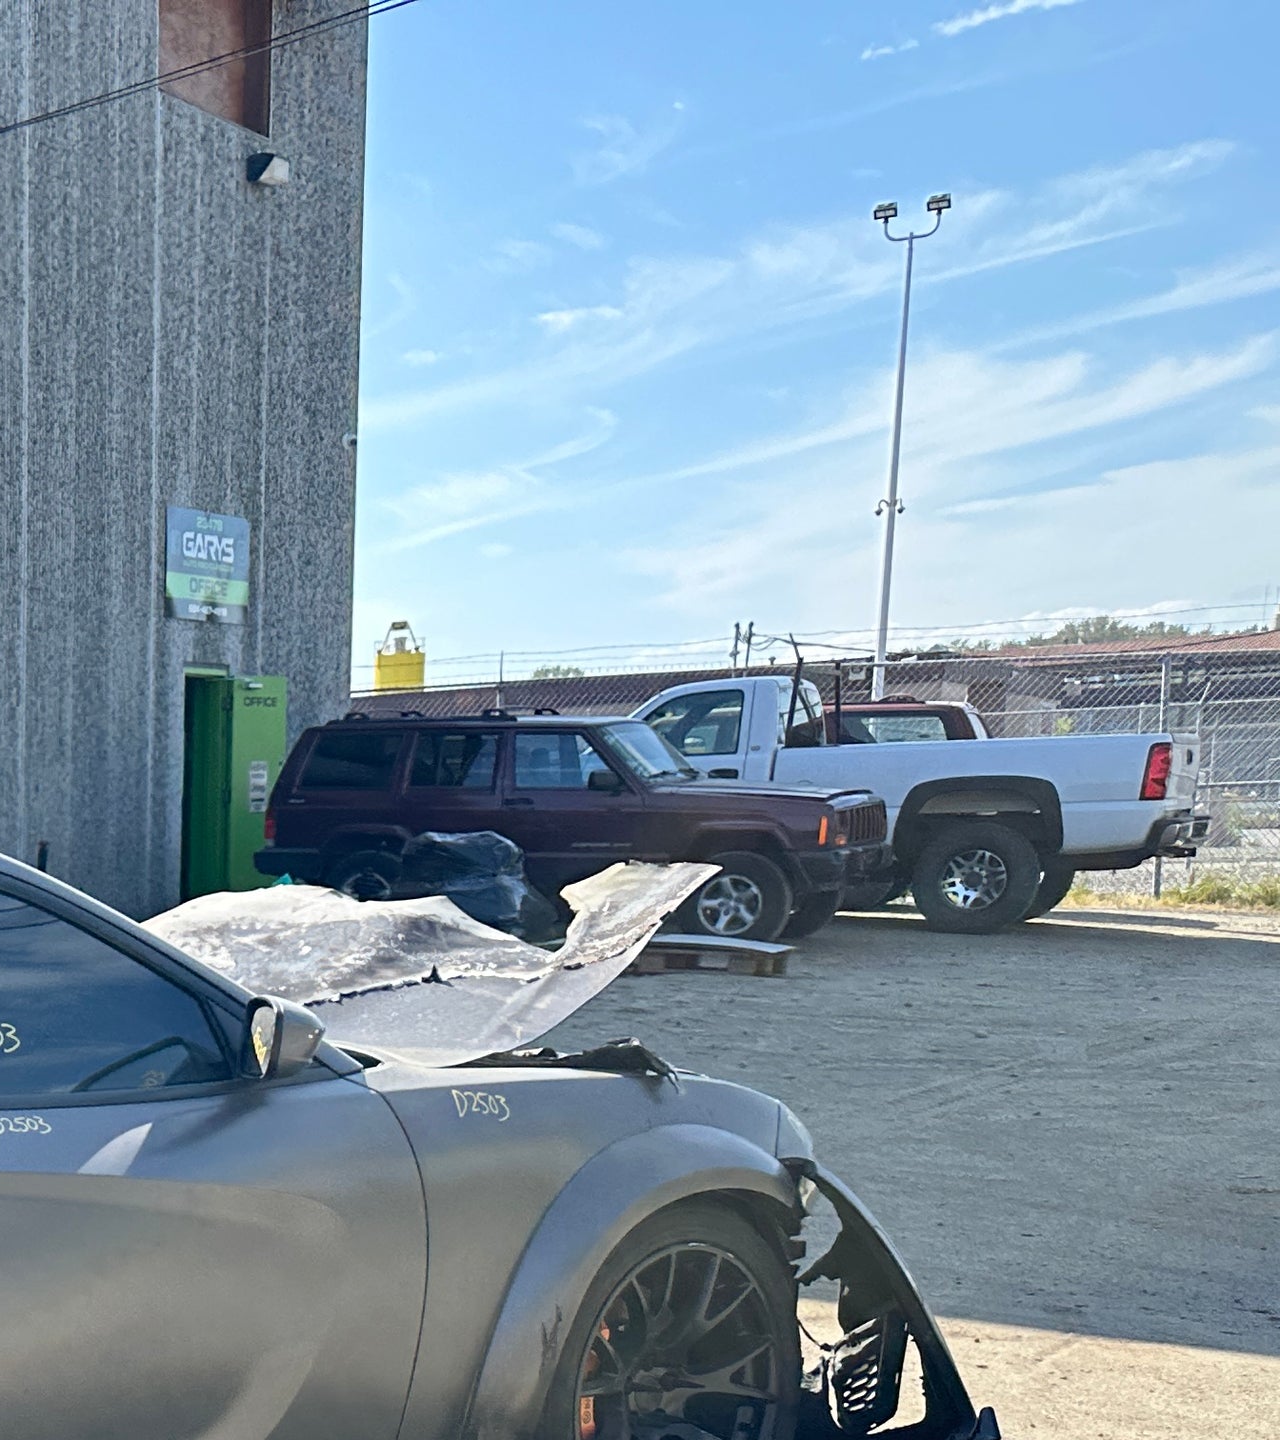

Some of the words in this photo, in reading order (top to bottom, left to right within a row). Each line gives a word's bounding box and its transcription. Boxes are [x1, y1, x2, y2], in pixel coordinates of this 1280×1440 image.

[183, 531, 234, 564] GARYS
[189, 577, 228, 596] OFFICE
[243, 696, 277, 707] OFFICE
[451, 1089, 510, 1122] D2503
